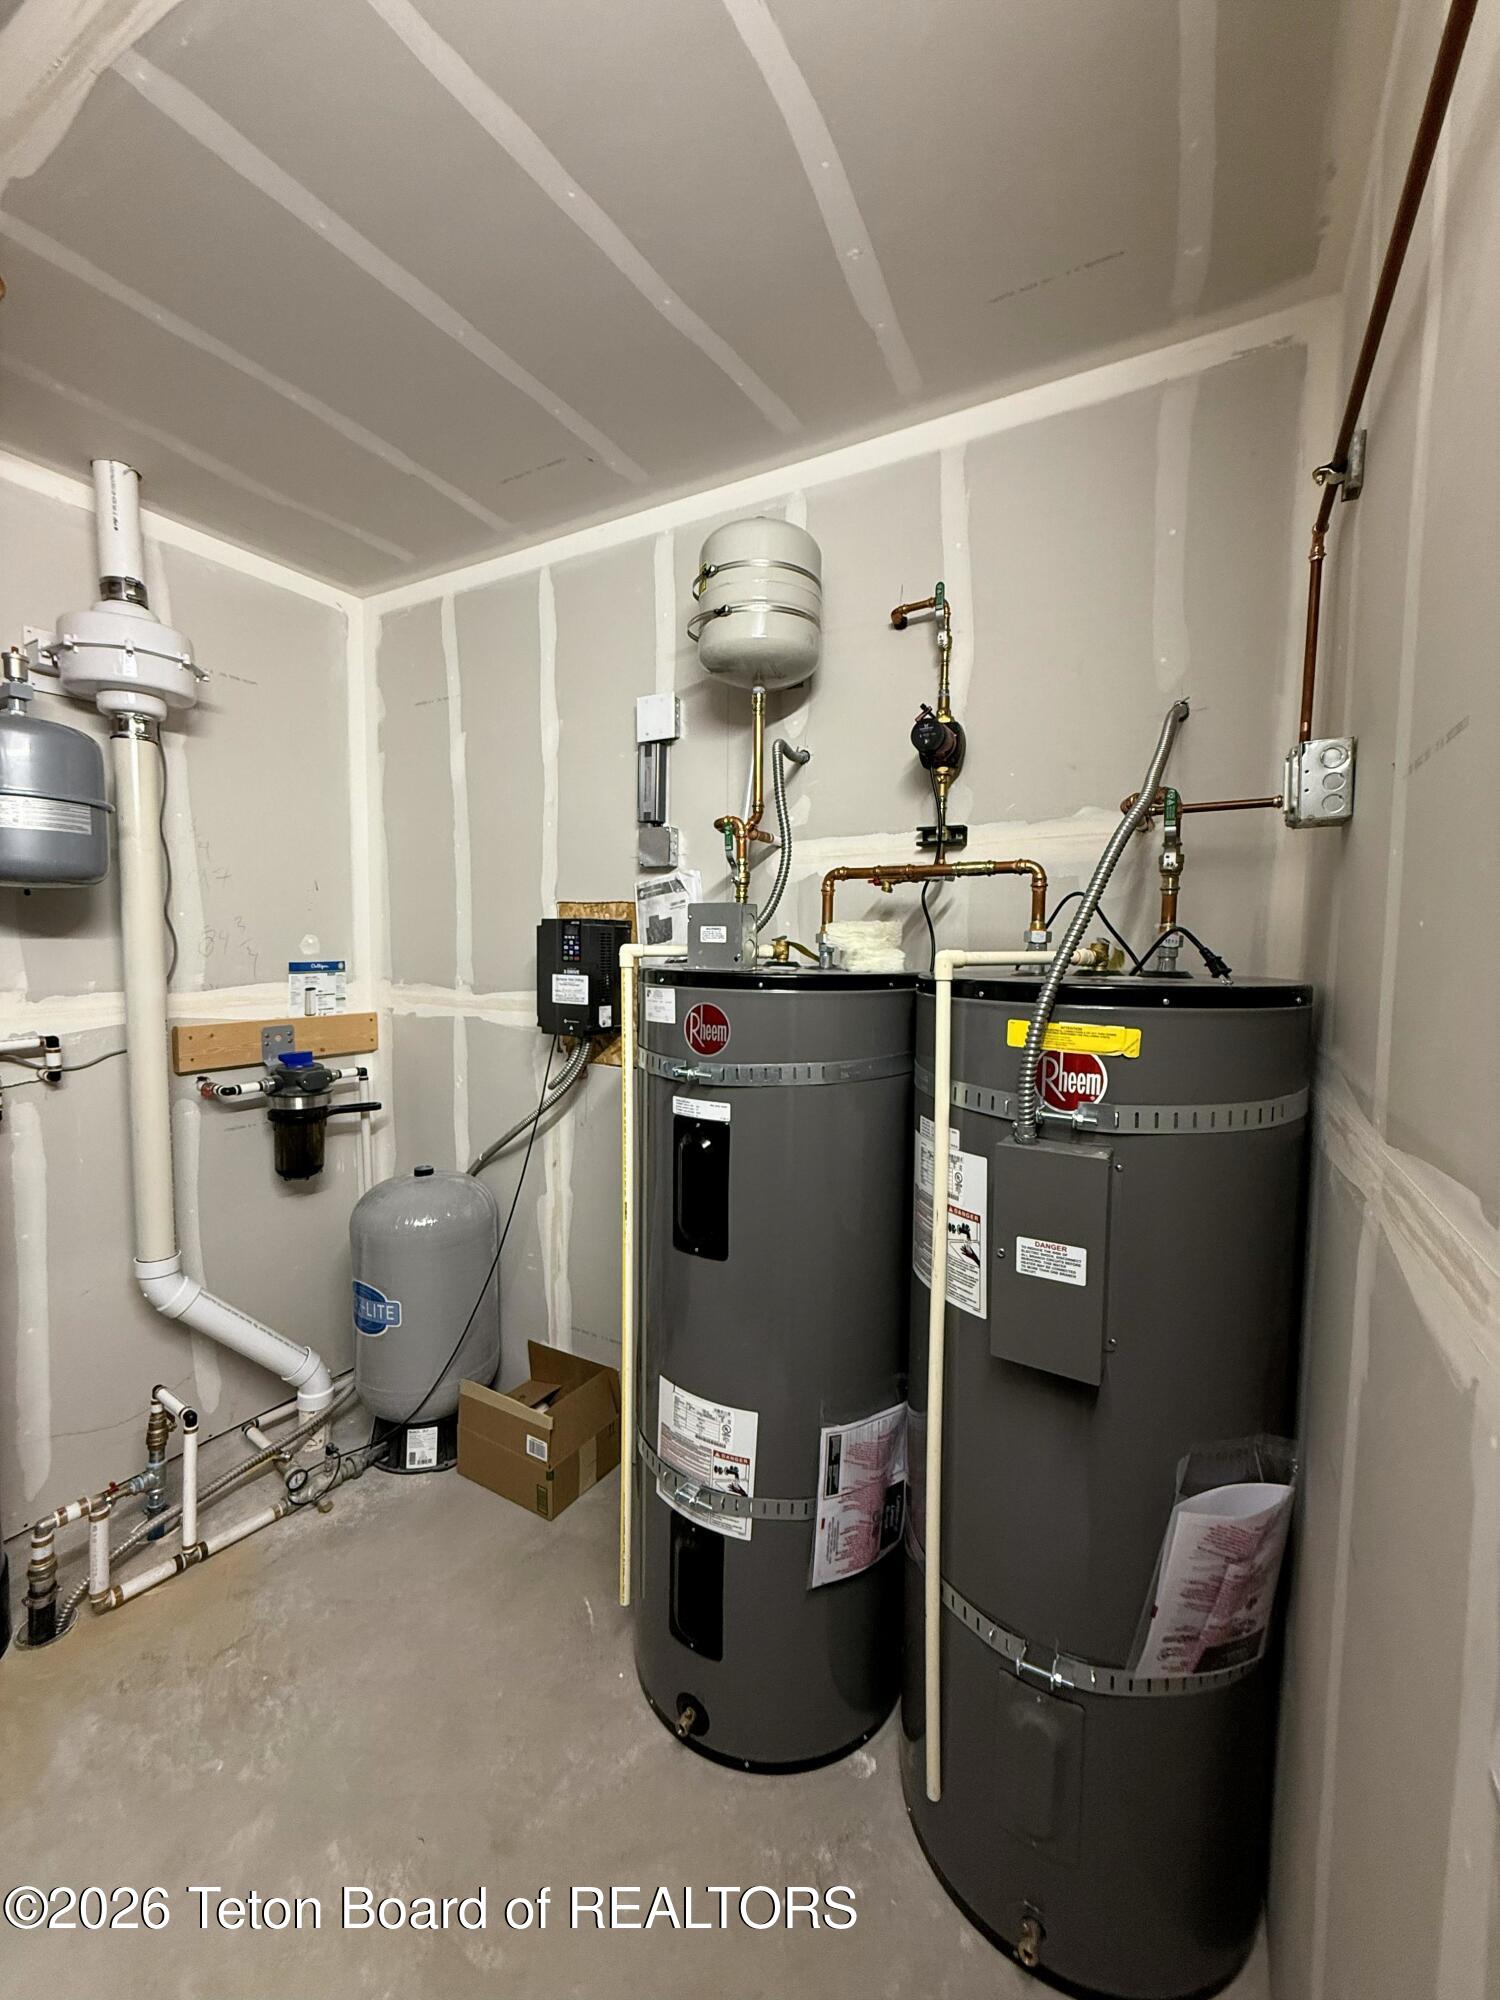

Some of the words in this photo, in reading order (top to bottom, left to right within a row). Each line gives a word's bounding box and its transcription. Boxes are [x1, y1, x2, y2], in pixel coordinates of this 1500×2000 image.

[689, 1004, 727, 1047] Rheem
[1041, 1052, 1102, 1102] Rheem
[953, 1207, 979, 1221] DANGER
[1034, 1241, 1068, 1252] DANGER
[358, 1301, 395, 1321] -LITE
